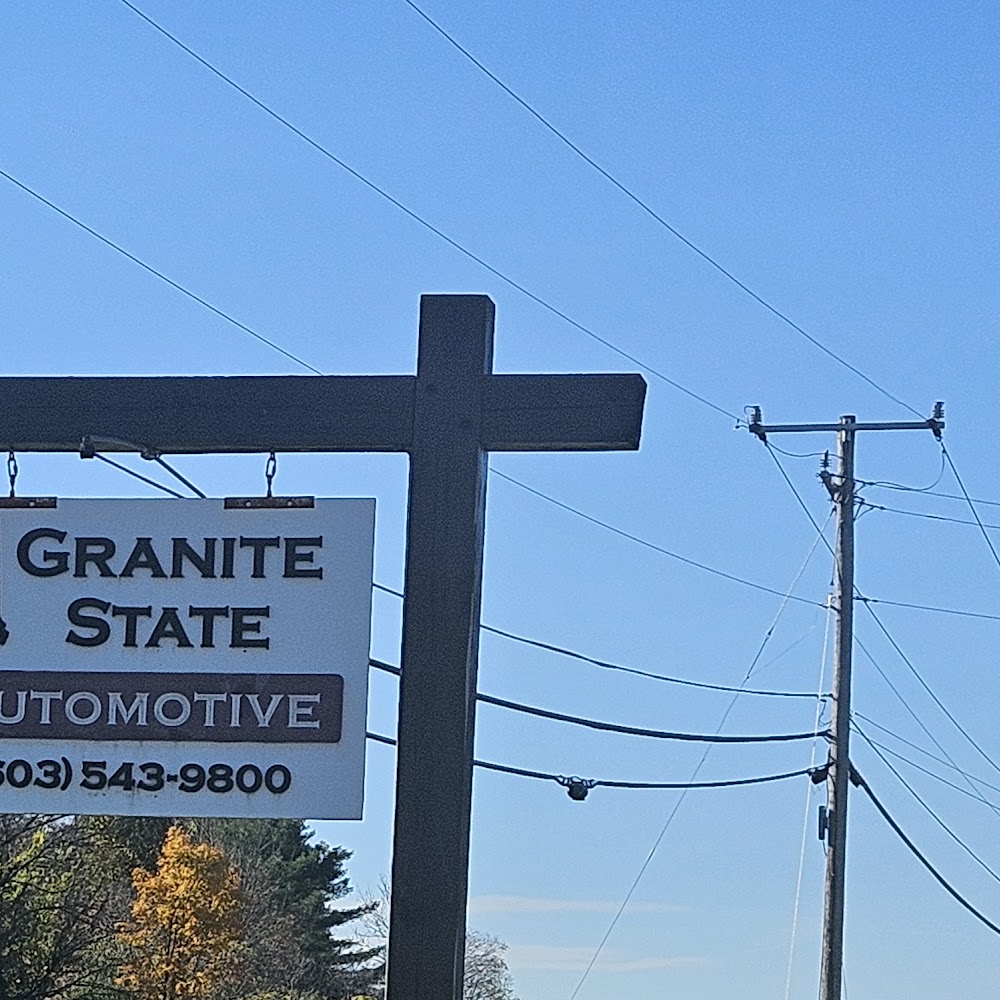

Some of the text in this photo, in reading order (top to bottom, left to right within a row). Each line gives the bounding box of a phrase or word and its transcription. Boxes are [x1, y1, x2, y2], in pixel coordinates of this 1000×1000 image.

[16, 527, 323, 580] GRANITE
[65, 597, 270, 650] STATE
[80, 761, 293, 794] 543-9800
